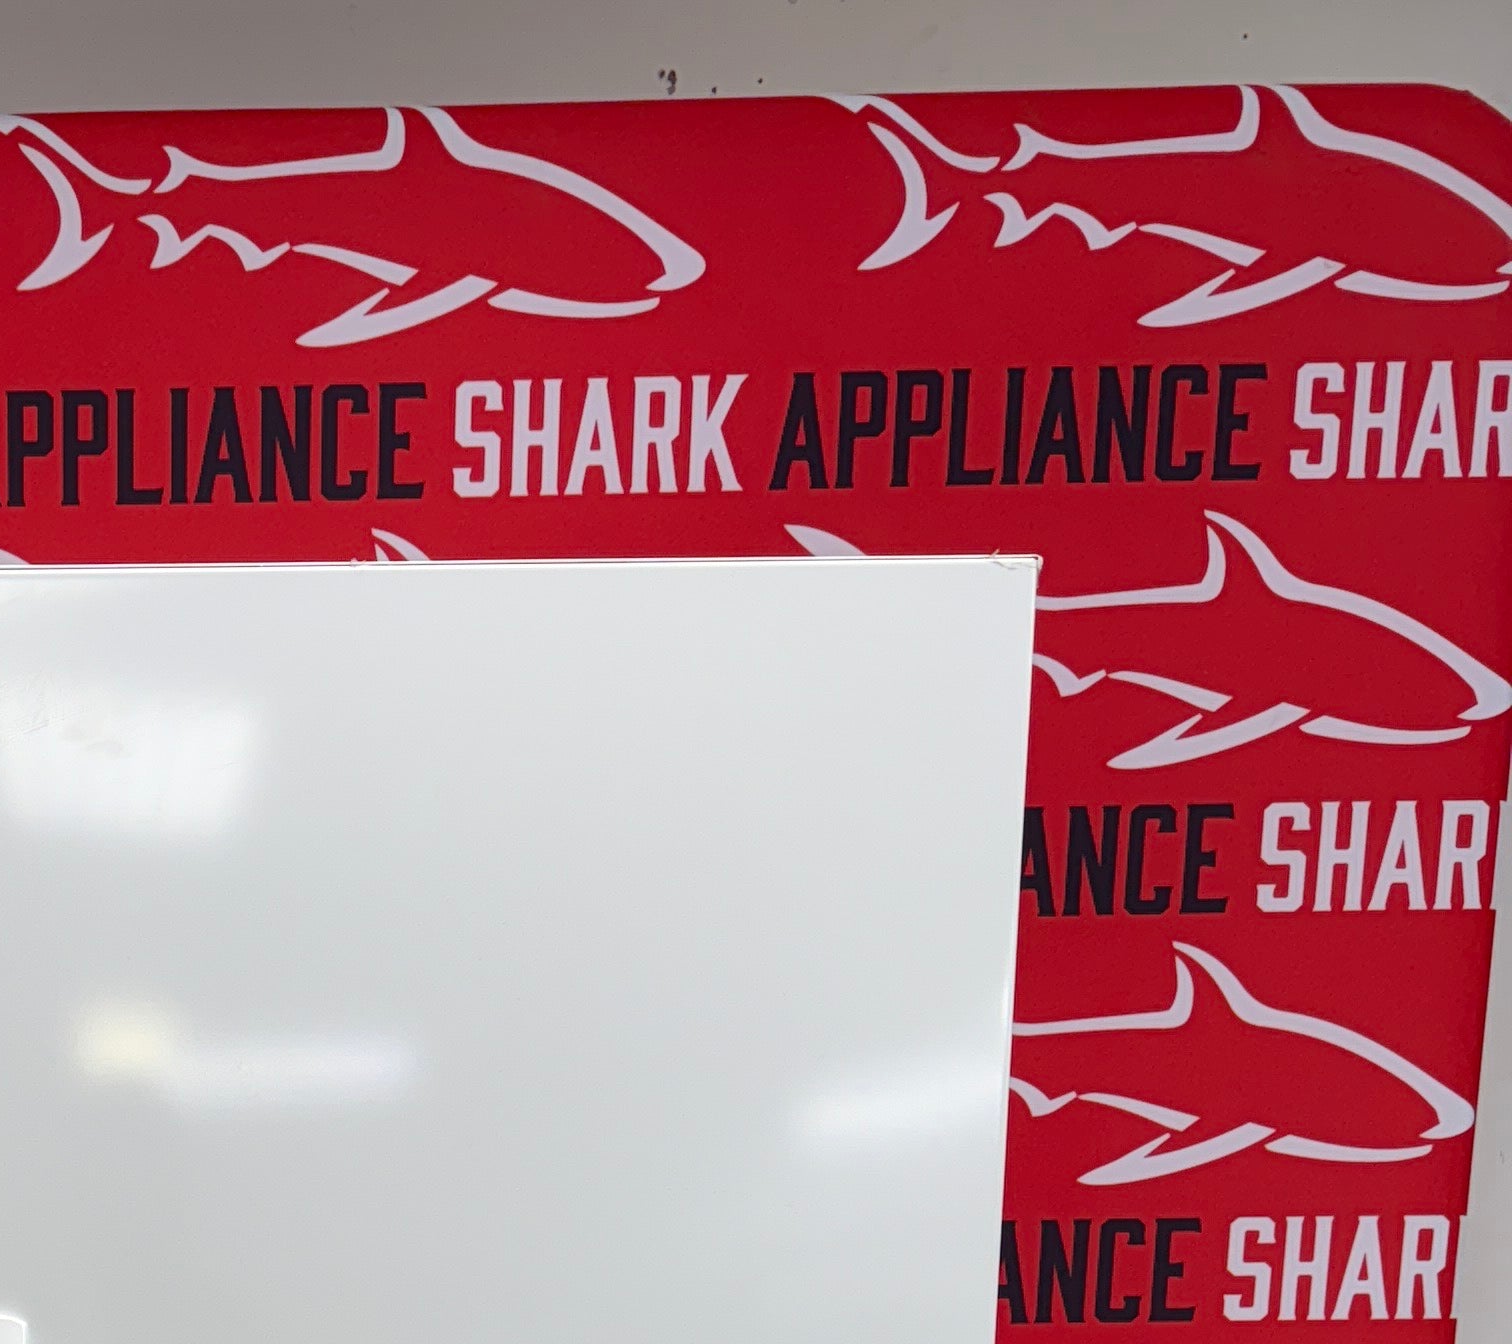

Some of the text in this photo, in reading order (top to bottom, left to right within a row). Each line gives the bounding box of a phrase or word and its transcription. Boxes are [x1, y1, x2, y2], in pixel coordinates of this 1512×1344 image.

[452, 373, 748, 498] SHARK
[769, 364, 1268, 490] APPLIANCE
[1289, 359, 1512, 480] SHAR
